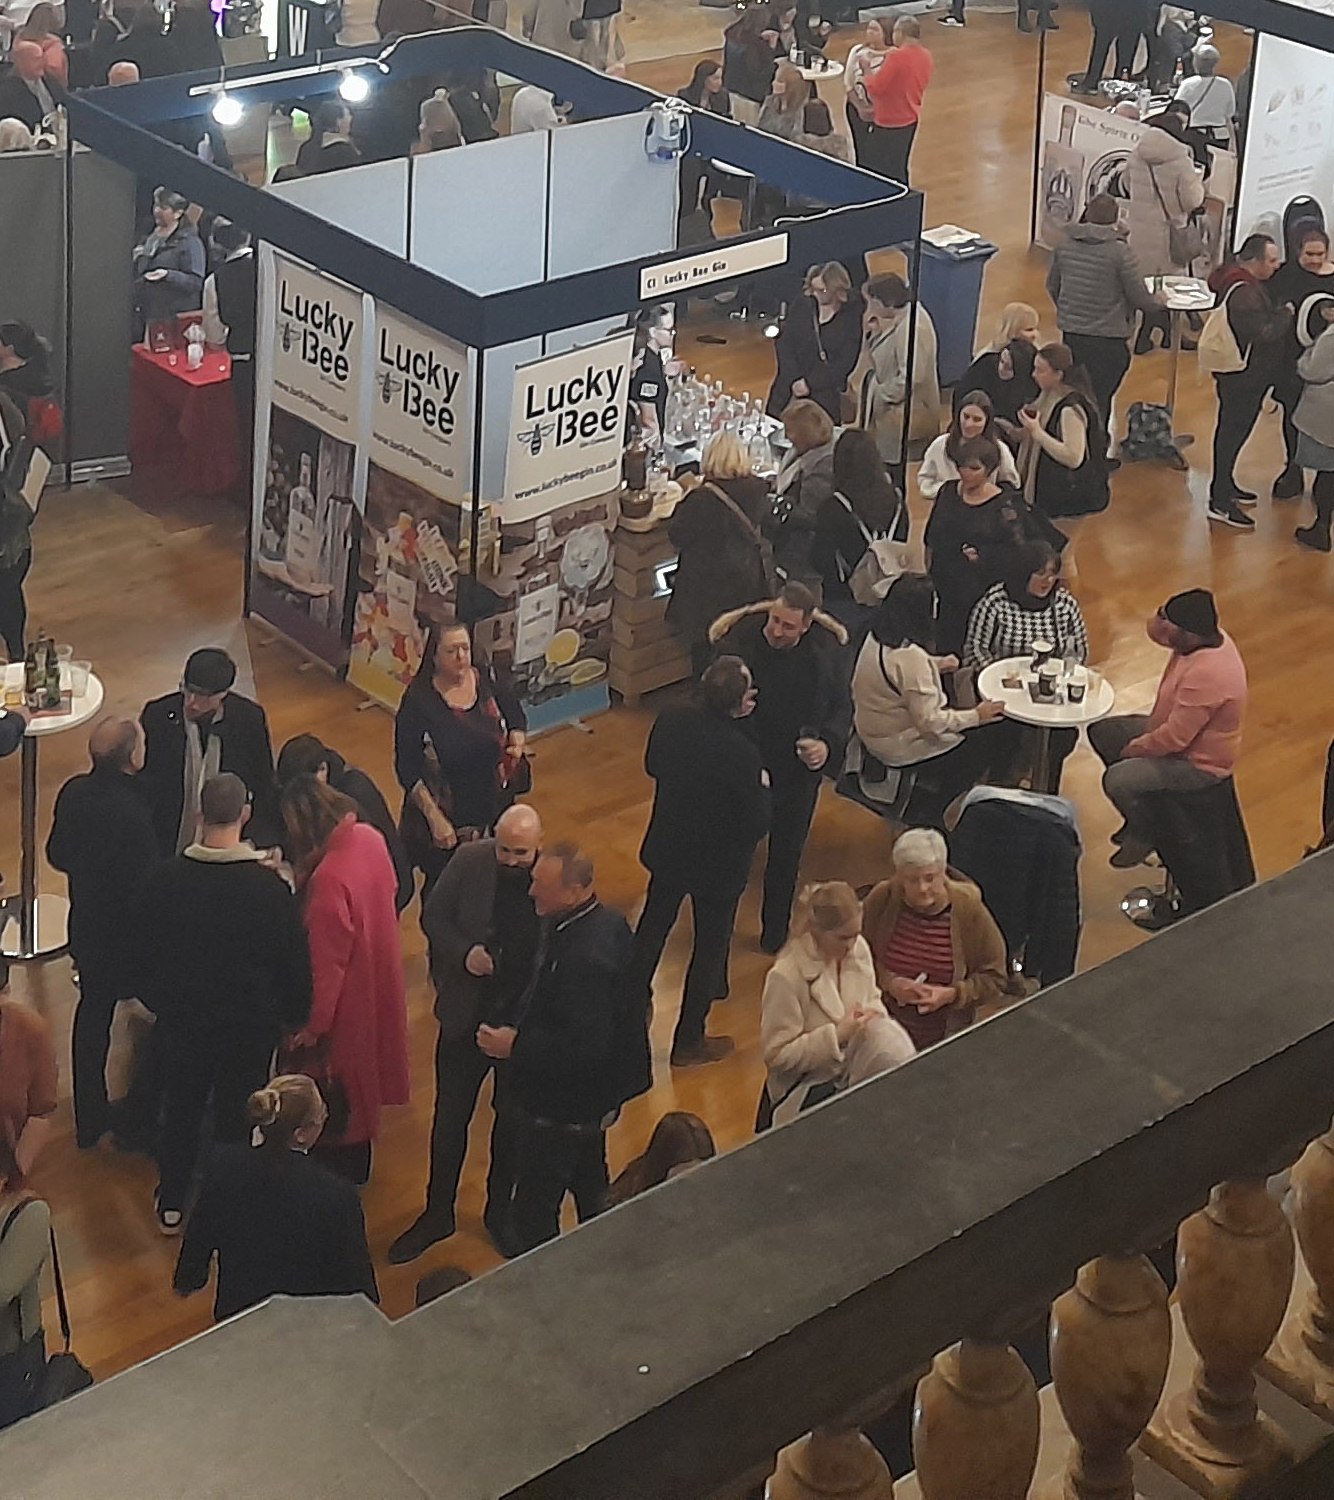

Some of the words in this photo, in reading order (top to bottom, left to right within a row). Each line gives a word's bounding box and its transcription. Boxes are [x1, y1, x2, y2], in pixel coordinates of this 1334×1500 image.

[664, 270, 689, 285] Lucky
[692, 267, 709, 278] Bee
[712, 261, 727, 272] Gin
[279, 280, 354, 352] Lucky
[301, 328, 349, 381] Bee
[380, 327, 460, 404] Lucky
[402, 378, 455, 435] Bee
[526, 365, 624, 420] Lucky
[555, 405, 619, 448] Bee
